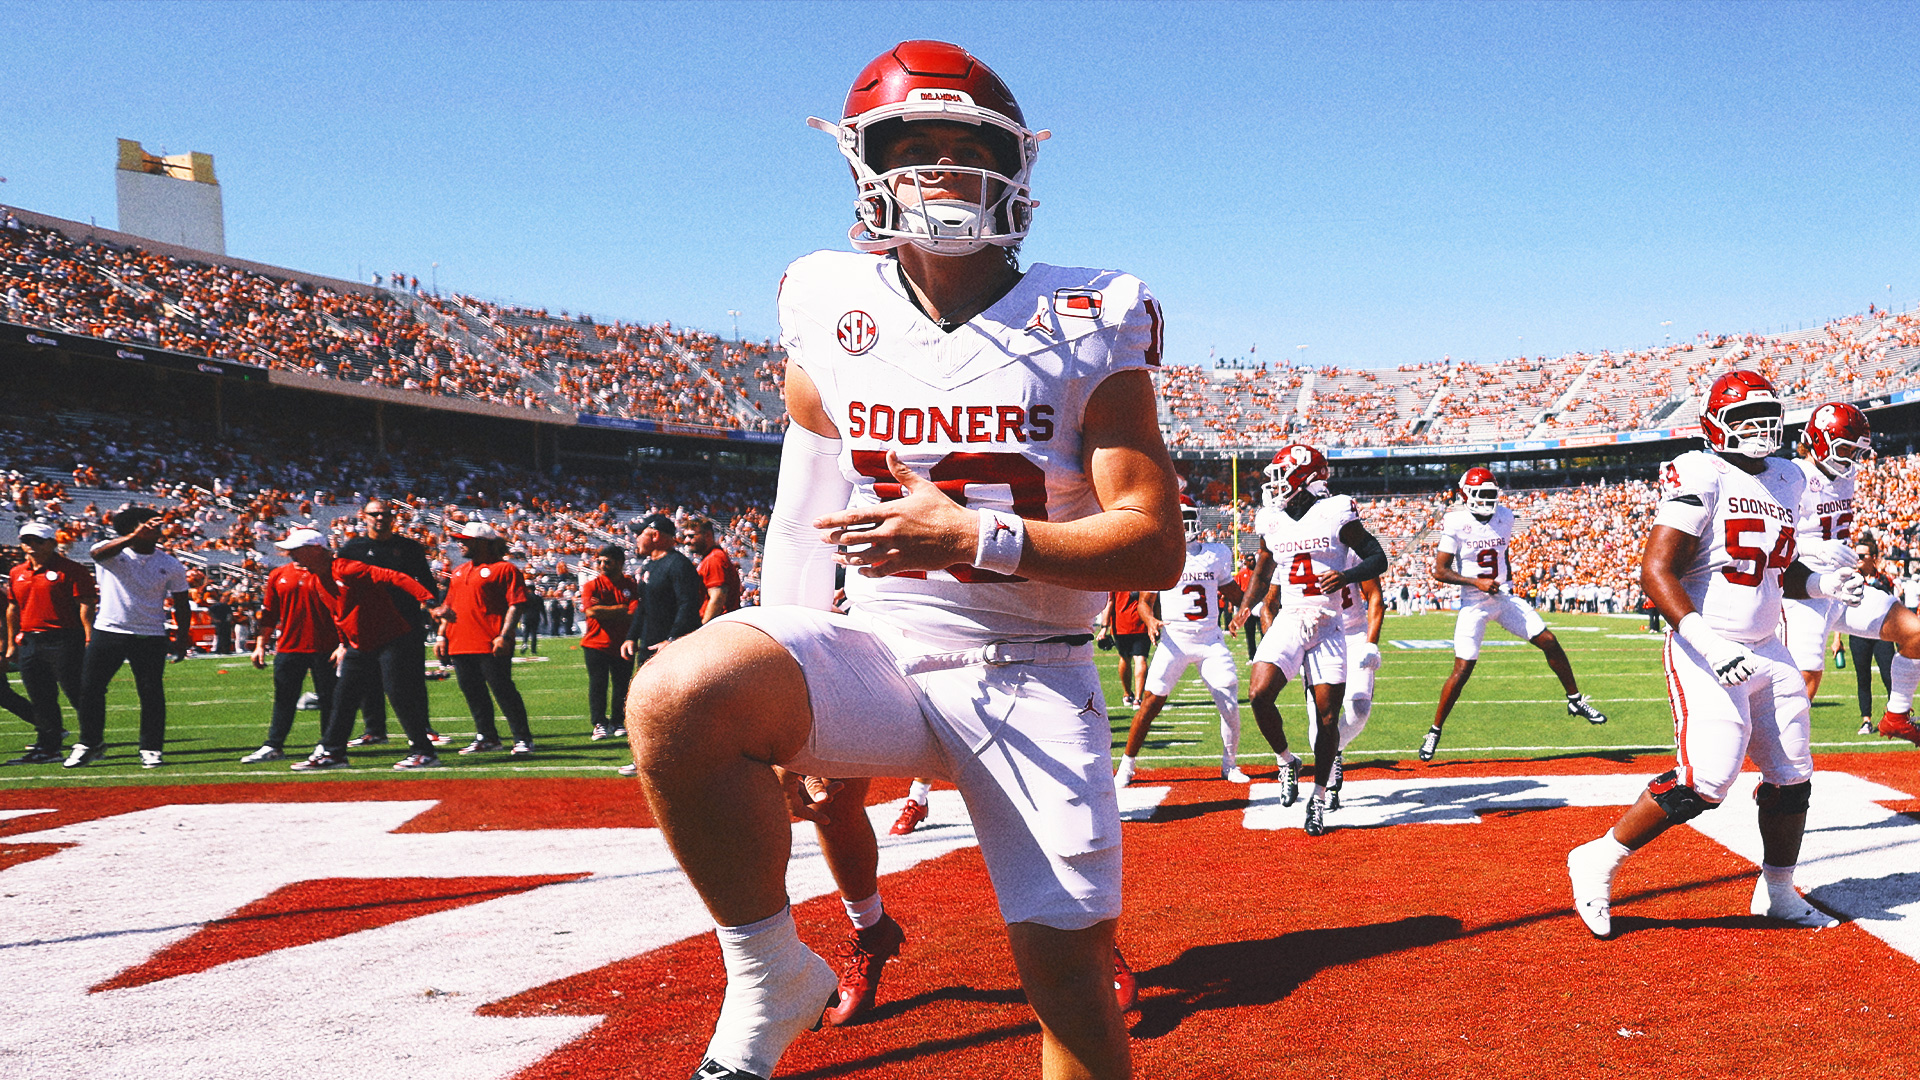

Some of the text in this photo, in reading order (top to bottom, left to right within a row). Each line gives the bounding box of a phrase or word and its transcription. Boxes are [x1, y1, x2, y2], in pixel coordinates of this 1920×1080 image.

[920, 93, 962, 102] OKLAHOMA
[837, 310, 876, 353] SEC
[849, 401, 1055, 445] SOONERS
[1729, 497, 1793, 524] SOONERS
[1816, 498, 1852, 515] SOONER
[1274, 536, 1330, 553] SOONERS
[1466, 537, 1506, 549] SOONERS
[1721, 518, 1797, 587] 54
[1288, 552, 1323, 597] 4
[1477, 548, 1499, 580] 9
[1182, 584, 1208, 621] 3
